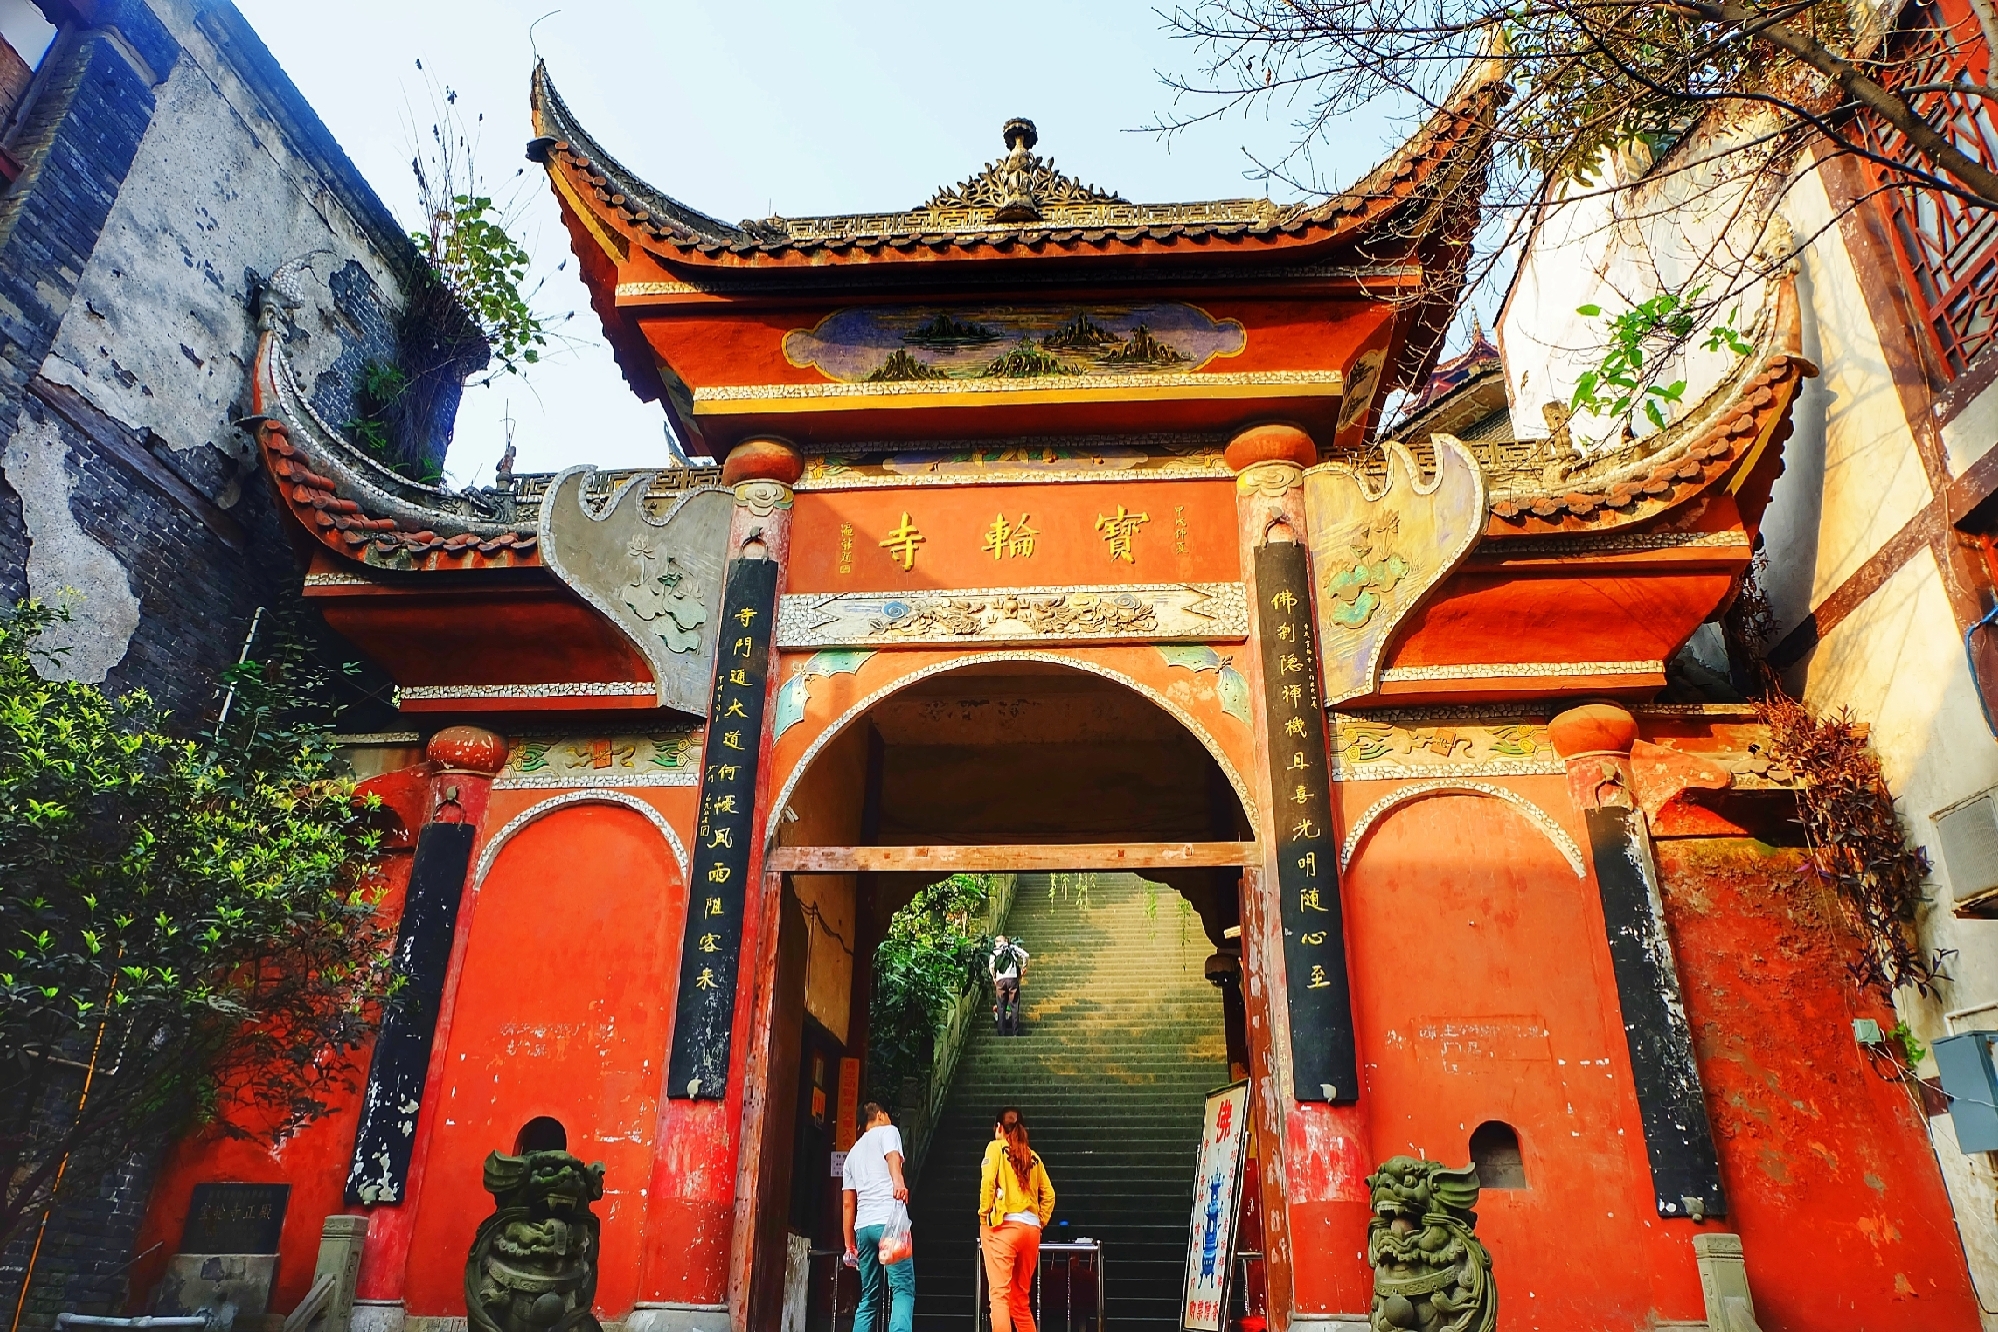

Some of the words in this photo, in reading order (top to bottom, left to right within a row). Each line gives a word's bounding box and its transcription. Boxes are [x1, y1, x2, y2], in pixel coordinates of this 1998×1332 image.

[879, 504, 1150, 571] 寶輪寺
[1215, 1098, 1233, 1143] 佛
